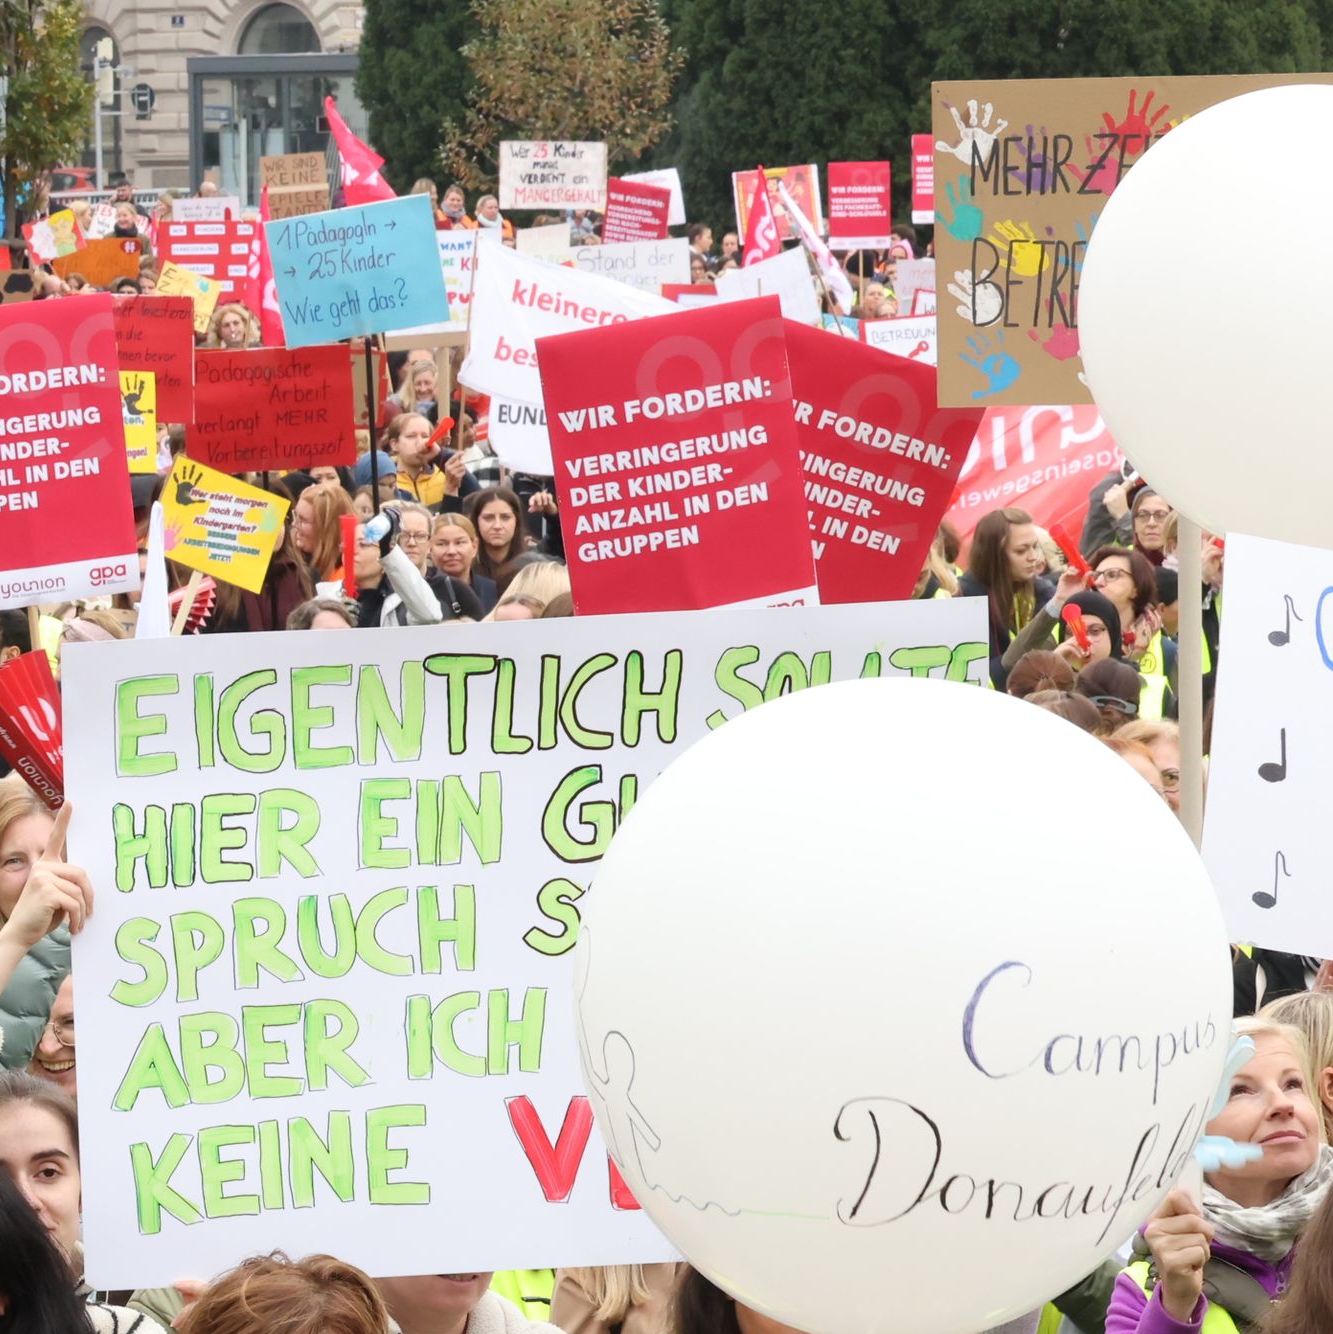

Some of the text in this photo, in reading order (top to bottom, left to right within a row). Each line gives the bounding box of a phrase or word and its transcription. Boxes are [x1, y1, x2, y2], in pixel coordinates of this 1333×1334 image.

[266, 168, 320, 186] KEINE
[969, 134, 1073, 197] MEHR
[284, 293, 324, 327] Wie
[368, 277, 410, 312] das?
[269, 379, 333, 405] Arbeit
[558, 377, 772, 433] WIR FORDERN:
[276, 408, 328, 427] MEHR
[817, 411, 952, 470] FORDERN:
[26, 463, 49, 484] IN
[54, 456, 100, 481] DEN
[564, 425, 769, 479] VERRINGERUNG
[190, 488, 269, 509] Wer steht morgen
[569, 465, 733, 507] DER KINDER-
[574, 481, 769, 535] ANZAHL IN DEN
[193, 516, 257, 533] Kindergarten?
[208, 506, 231, 517] noch
[577, 525, 700, 563] GRUPPEN
[821, 517, 901, 557] IN DEN
[0, 575, 67, 599] younion
[89, 563, 127, 587] gpa
[115, 648, 684, 778] EIGENTLICH
[113, 770, 502, 894] HIER EIN
[109, 882, 477, 1008] SPRUCH
[110, 985, 548, 1112] ABER ICH
[962, 959, 1217, 1105] Campus
[128, 1102, 432, 1236] KEINE
